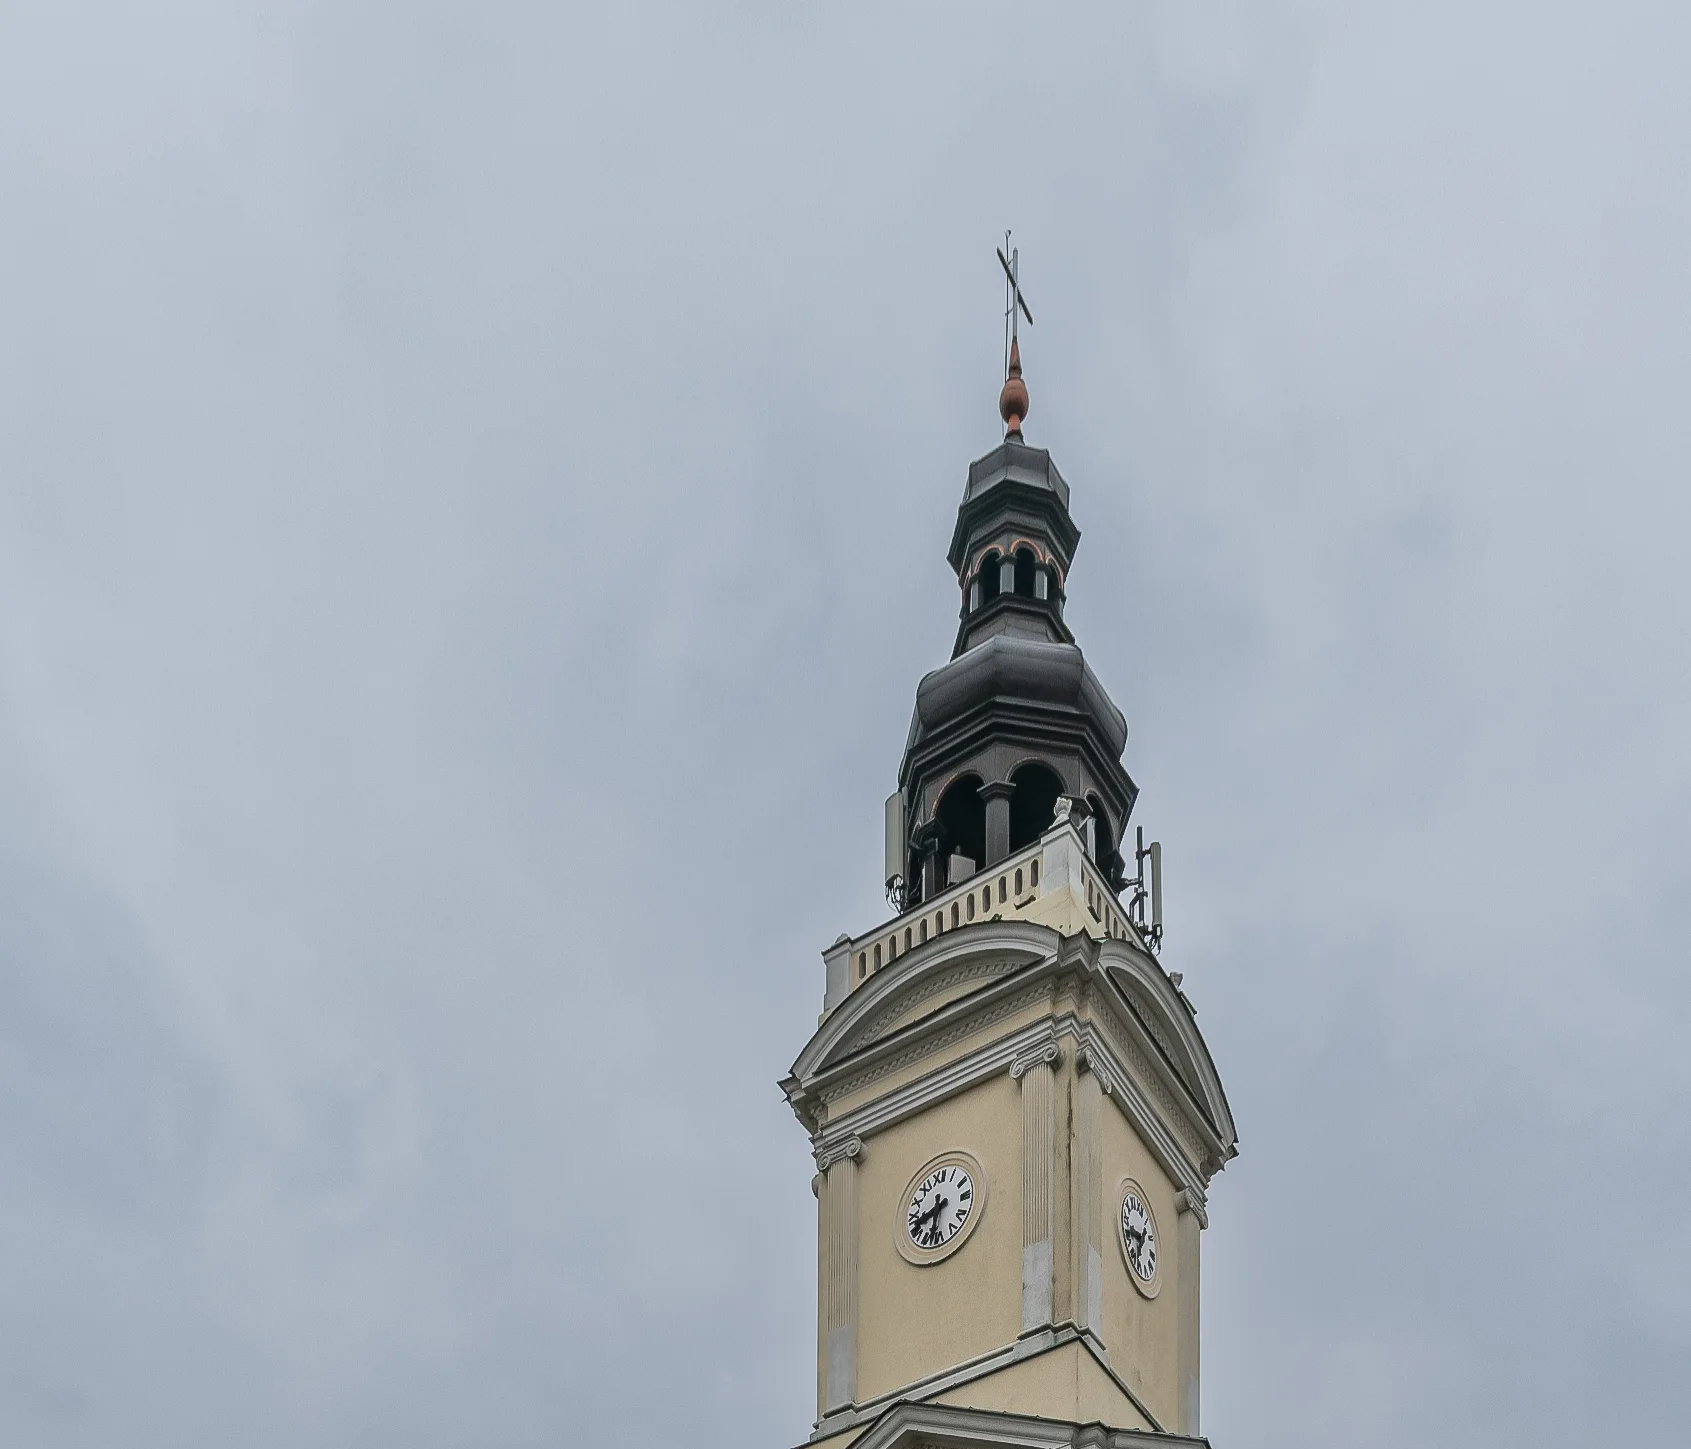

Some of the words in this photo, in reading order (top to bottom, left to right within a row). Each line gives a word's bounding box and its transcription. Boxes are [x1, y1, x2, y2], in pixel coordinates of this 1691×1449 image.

[932, 1169, 947, 1187] XII
[919, 1179, 933, 1197] XI
[911, 1197, 923, 1208] X
[948, 1222, 958, 1235] V
